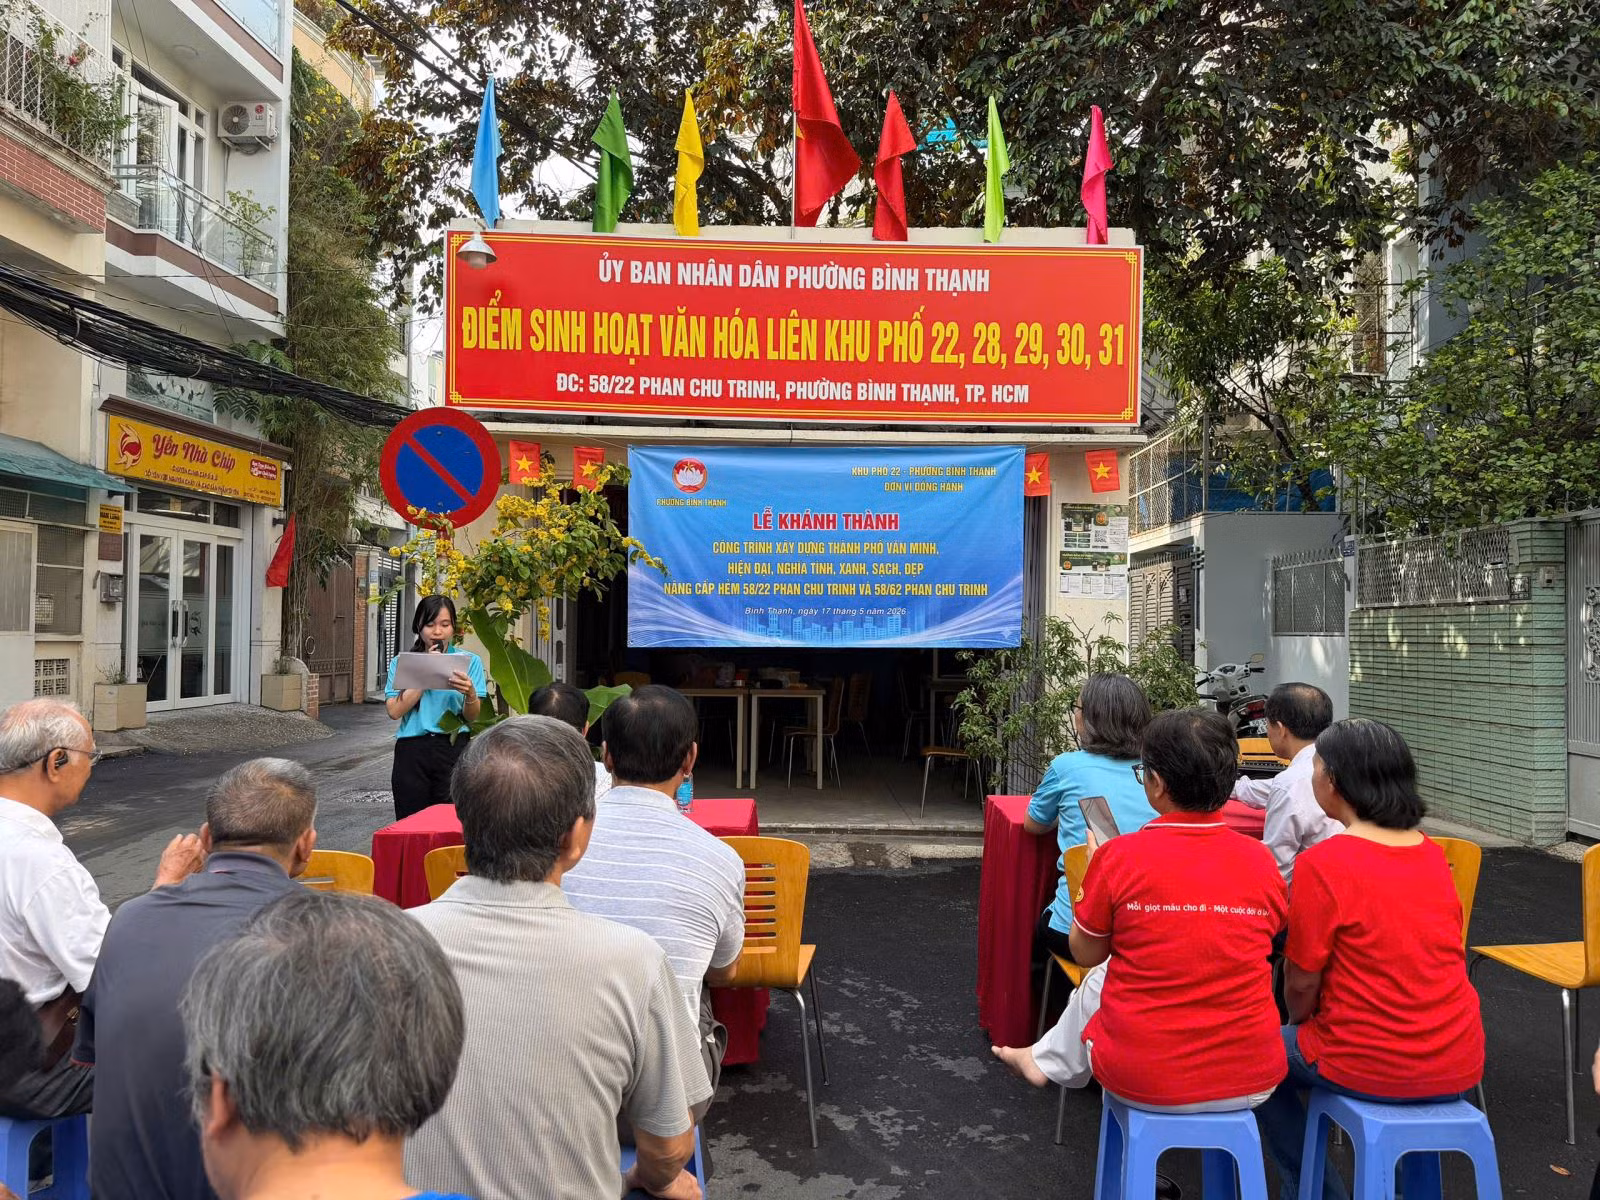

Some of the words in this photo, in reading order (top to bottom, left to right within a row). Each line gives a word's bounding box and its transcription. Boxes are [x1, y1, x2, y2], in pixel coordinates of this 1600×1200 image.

[599, 251, 624, 283] ỦY
[630, 260, 670, 285] BAN
[677, 258, 732, 287] NHÂN
[738, 260, 779, 288] DÂN
[786, 261, 866, 290] PHƯỜNG
[871, 263, 919, 291] BÌNH
[925, 268, 990, 297] THẠNH
[462, 289, 522, 351] ĐIỂM
[530, 308, 586, 353] SINH
[593, 312, 653, 365] HOẠT
[659, 306, 705, 358] VĂN
[713, 308, 760, 360] HÓA
[767, 309, 817, 361] LIÊN
[824, 319, 871, 362] KHU
[878, 305, 925, 363] PHỐ
[930, 321, 965, 369] 22,
[972, 321, 1007, 369] 28,
[1014, 322, 1049, 370] 29,
[1056, 323, 1091, 370] 30,
[1099, 323, 1124, 366] 31
[556, 373, 584, 392] ĐC:
[589, 375, 635, 395] 58/22
[639, 376, 685, 397] PHAN
[689, 378, 722, 398] CHU
[727, 379, 780, 401] TRINH,
[786, 377, 852, 400] PHƯỜNG
[857, 378, 897, 401] BÌNH
[901, 383, 960, 406] THẠNH,
[965, 384, 986, 403] TP.
[991, 384, 1029, 403] HCM
[153, 433, 179, 460] Yến
[182, 441, 208, 464] Nhà
[211, 450, 236, 473] Chip
[852, 467, 868, 476] KHU
[890, 467, 900, 476] 22
[752, 507, 773, 531] LỄ
[777, 508, 838, 530] KHÁNH
[842, 509, 900, 530] THÀNH
[713, 540, 740, 554] CÔNG
[743, 540, 772, 554] TRÌNH
[776, 540, 795, 554] XÂY
[797, 541, 825, 556] DỰNG
[828, 540, 860, 554] THÀNH
[864, 540, 884, 554] PHỐ
[728, 560, 751, 577] HIỆN
[839, 562, 869, 576] XANH,
[904, 563, 924, 578] ĐẸP
[664, 580, 692, 595] NÂNG
[695, 578, 715, 595] CẤP
[718, 579, 740, 595] HẺM
[743, 583, 770, 595] 58/22
[774, 583, 800, 595] PHAN
[804, 583, 824, 595] CHU
[827, 583, 856, 596] TRINH
[859, 581, 872, 596] VÀ
[874, 584, 902, 596] 58/62
[904, 584, 932, 596] PHAN
[936, 584, 956, 596] CHU
[958, 584, 988, 596] TRINH
[1144, 903, 1161, 913] giọt
[1162, 902, 1181, 911] máu
[1183, 903, 1198, 912] cho
[1200, 904, 1207, 912] đi
[1214, 904, 1229, 914] Một
[1230, 906, 1246, 916] cuộc
